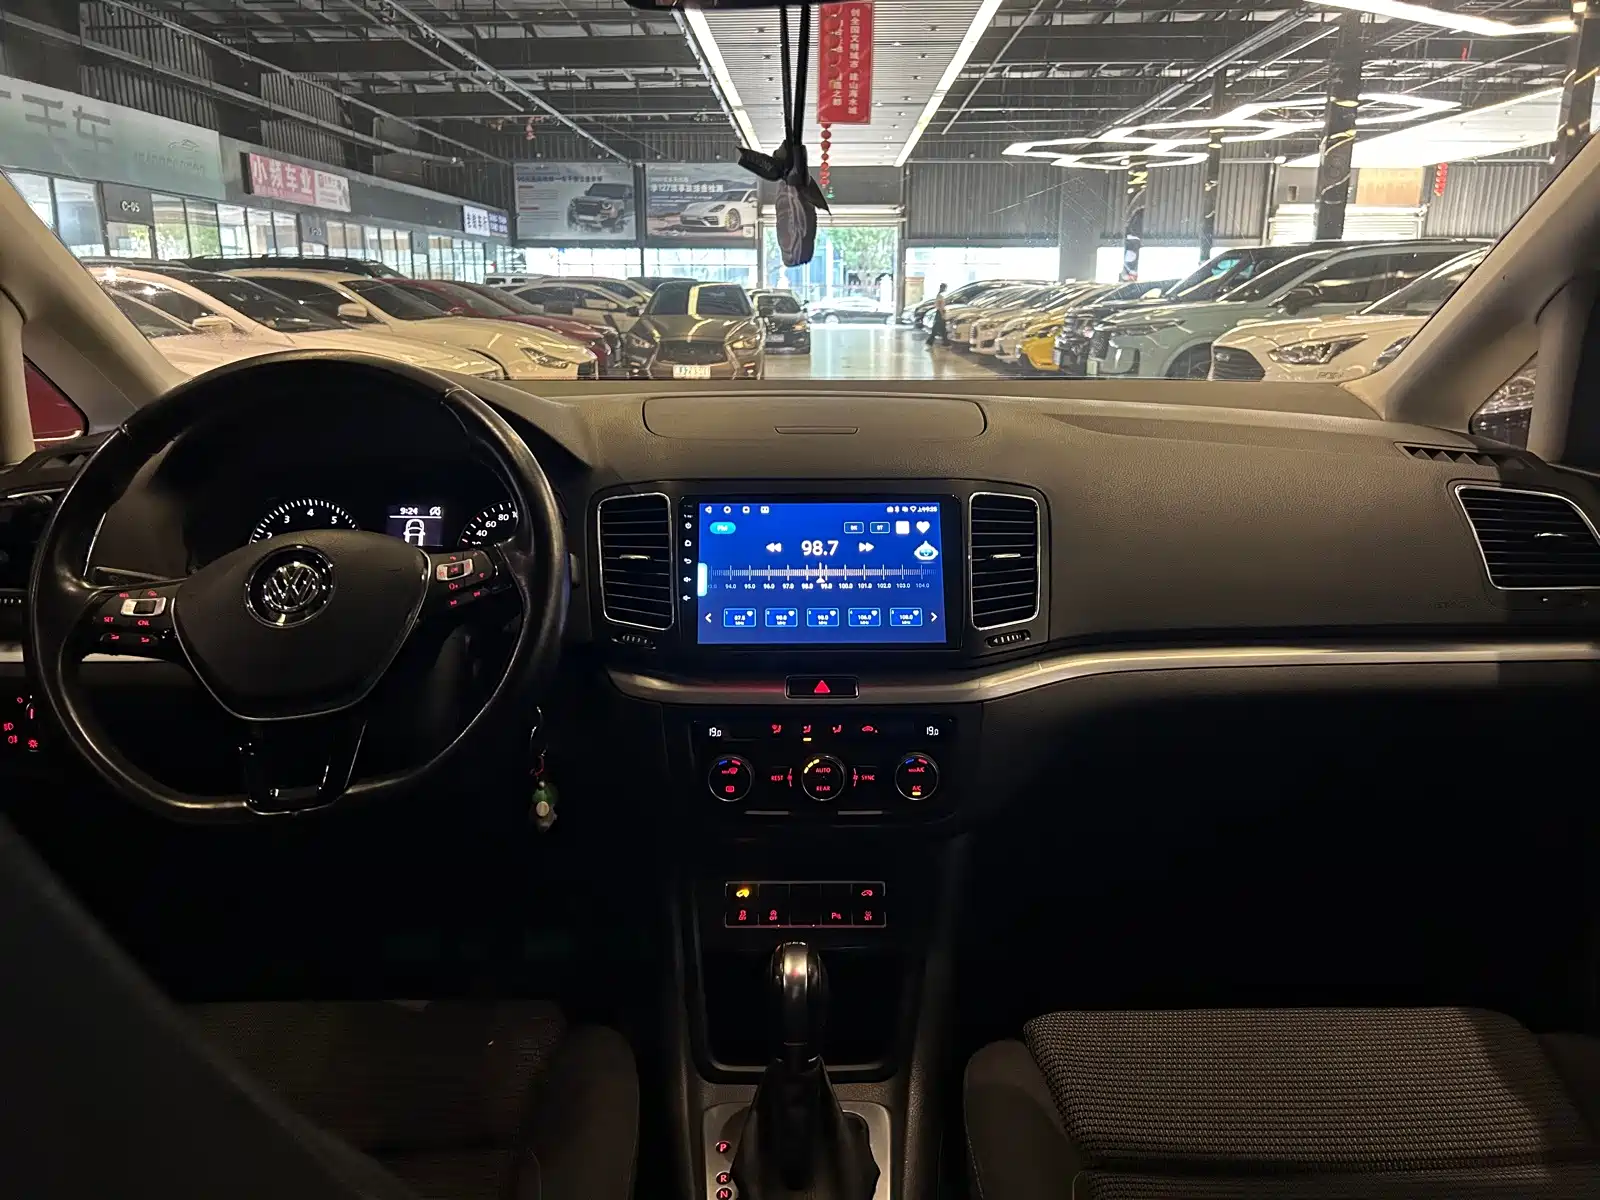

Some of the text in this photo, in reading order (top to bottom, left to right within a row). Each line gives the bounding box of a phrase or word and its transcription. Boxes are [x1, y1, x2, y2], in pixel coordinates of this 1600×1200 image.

[121, 200, 141, 213] C-05
[306, 508, 315, 517] 4
[399, 506, 419, 515] 9:24
[283, 514, 291, 524] 3
[330, 516, 338, 525] 5
[497, 513, 510, 521] 80
[485, 520, 497, 528] 60
[475, 529, 488, 537] 40
[801, 540, 839, 556] 98.7
[861, 774, 875, 782] SYNC
[719, 1143, 727, 1152] P
[720, 1174, 727, 1182] R
[720, 1190, 728, 1198] N
